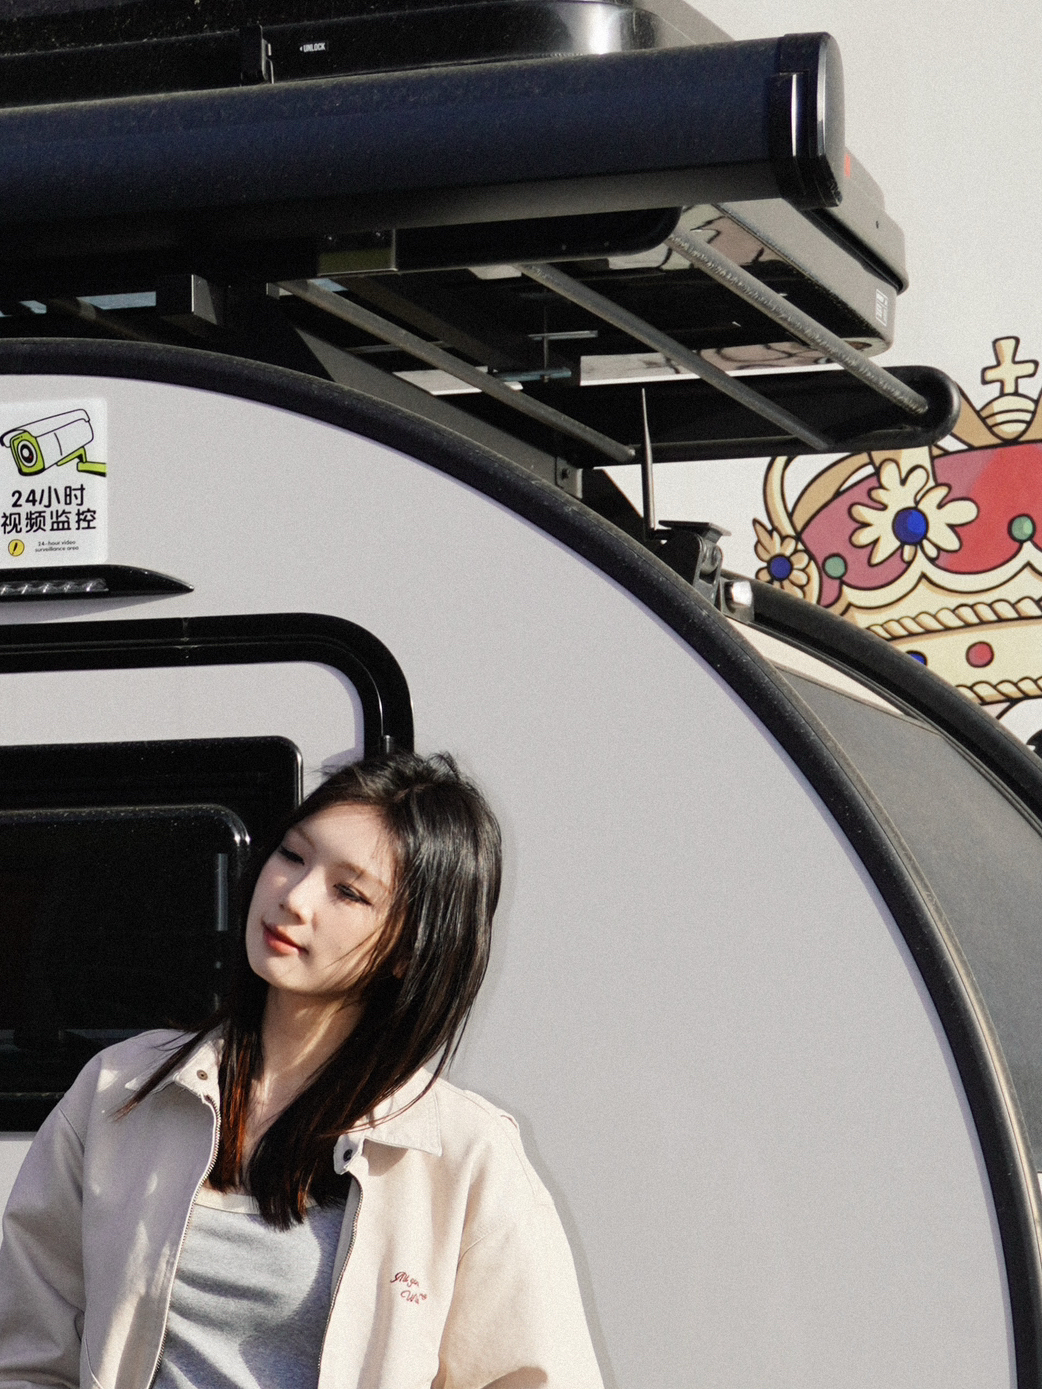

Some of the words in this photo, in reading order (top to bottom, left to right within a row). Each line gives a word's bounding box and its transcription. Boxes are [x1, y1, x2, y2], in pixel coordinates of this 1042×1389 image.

[303, 42, 326, 53] UNLOCK
[11, 483, 86, 508] 24小时
[1, 508, 97, 535] 视频监控
